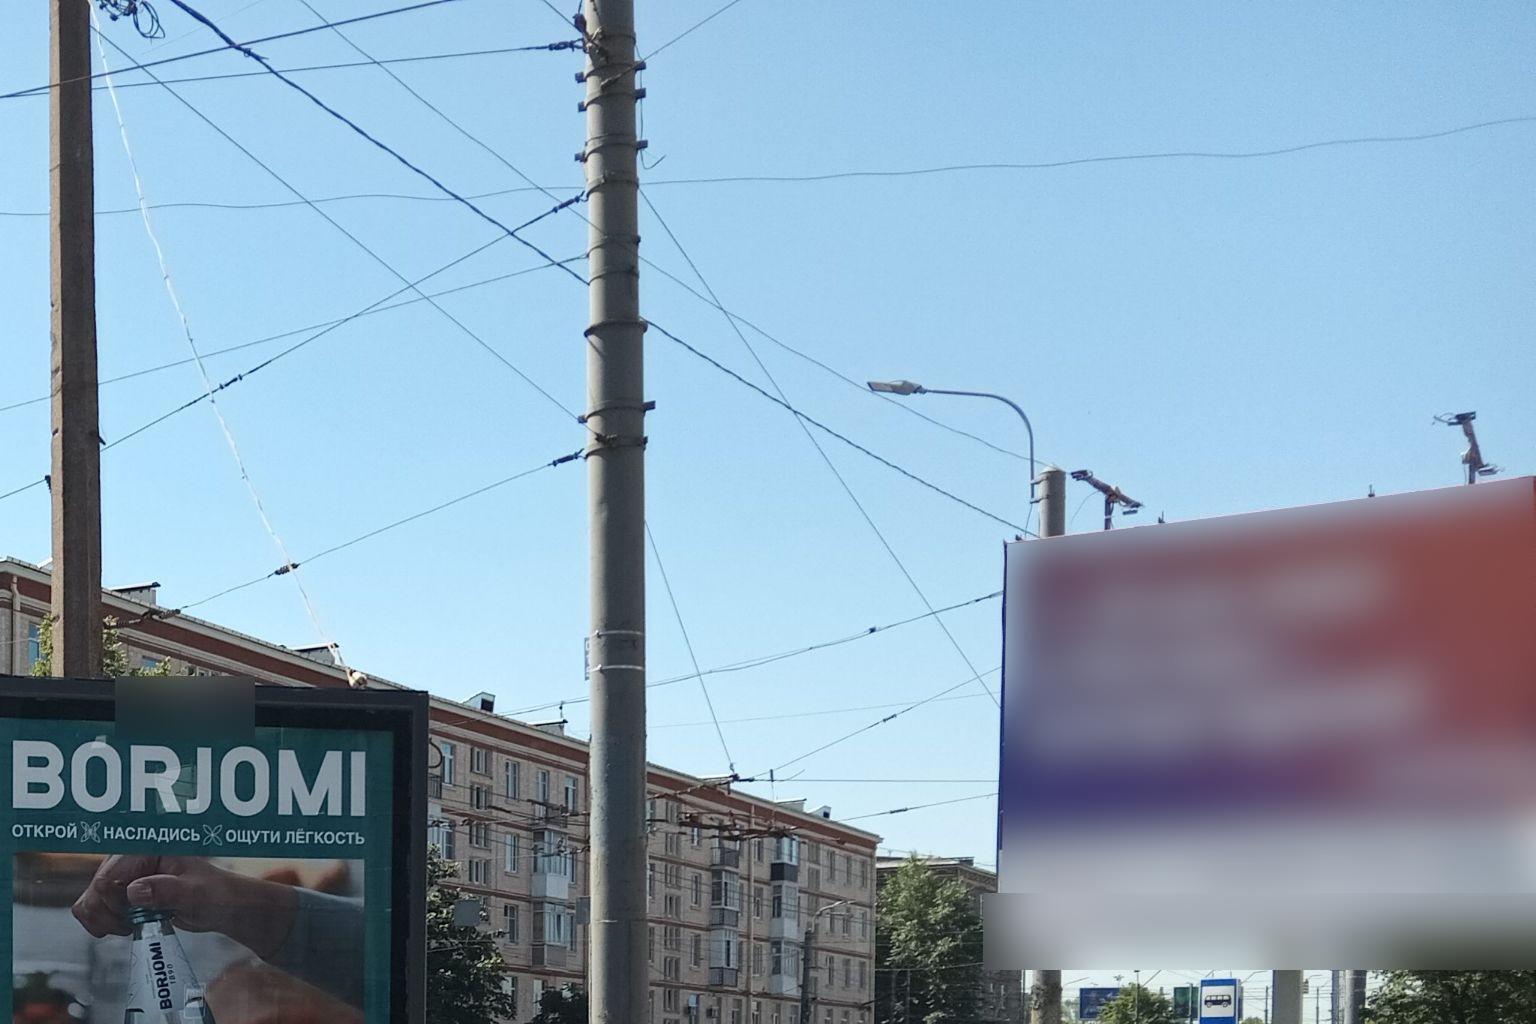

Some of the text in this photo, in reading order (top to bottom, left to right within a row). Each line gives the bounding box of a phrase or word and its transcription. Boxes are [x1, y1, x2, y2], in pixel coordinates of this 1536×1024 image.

[12, 740, 366, 818] BORJOMI
[12, 823, 365, 845] ОТКРОЙ НАСЛАДИСЬ ОЩУТИ ЛЁГКОСТЬ
[149, 941, 173, 1010] BORJOMI
